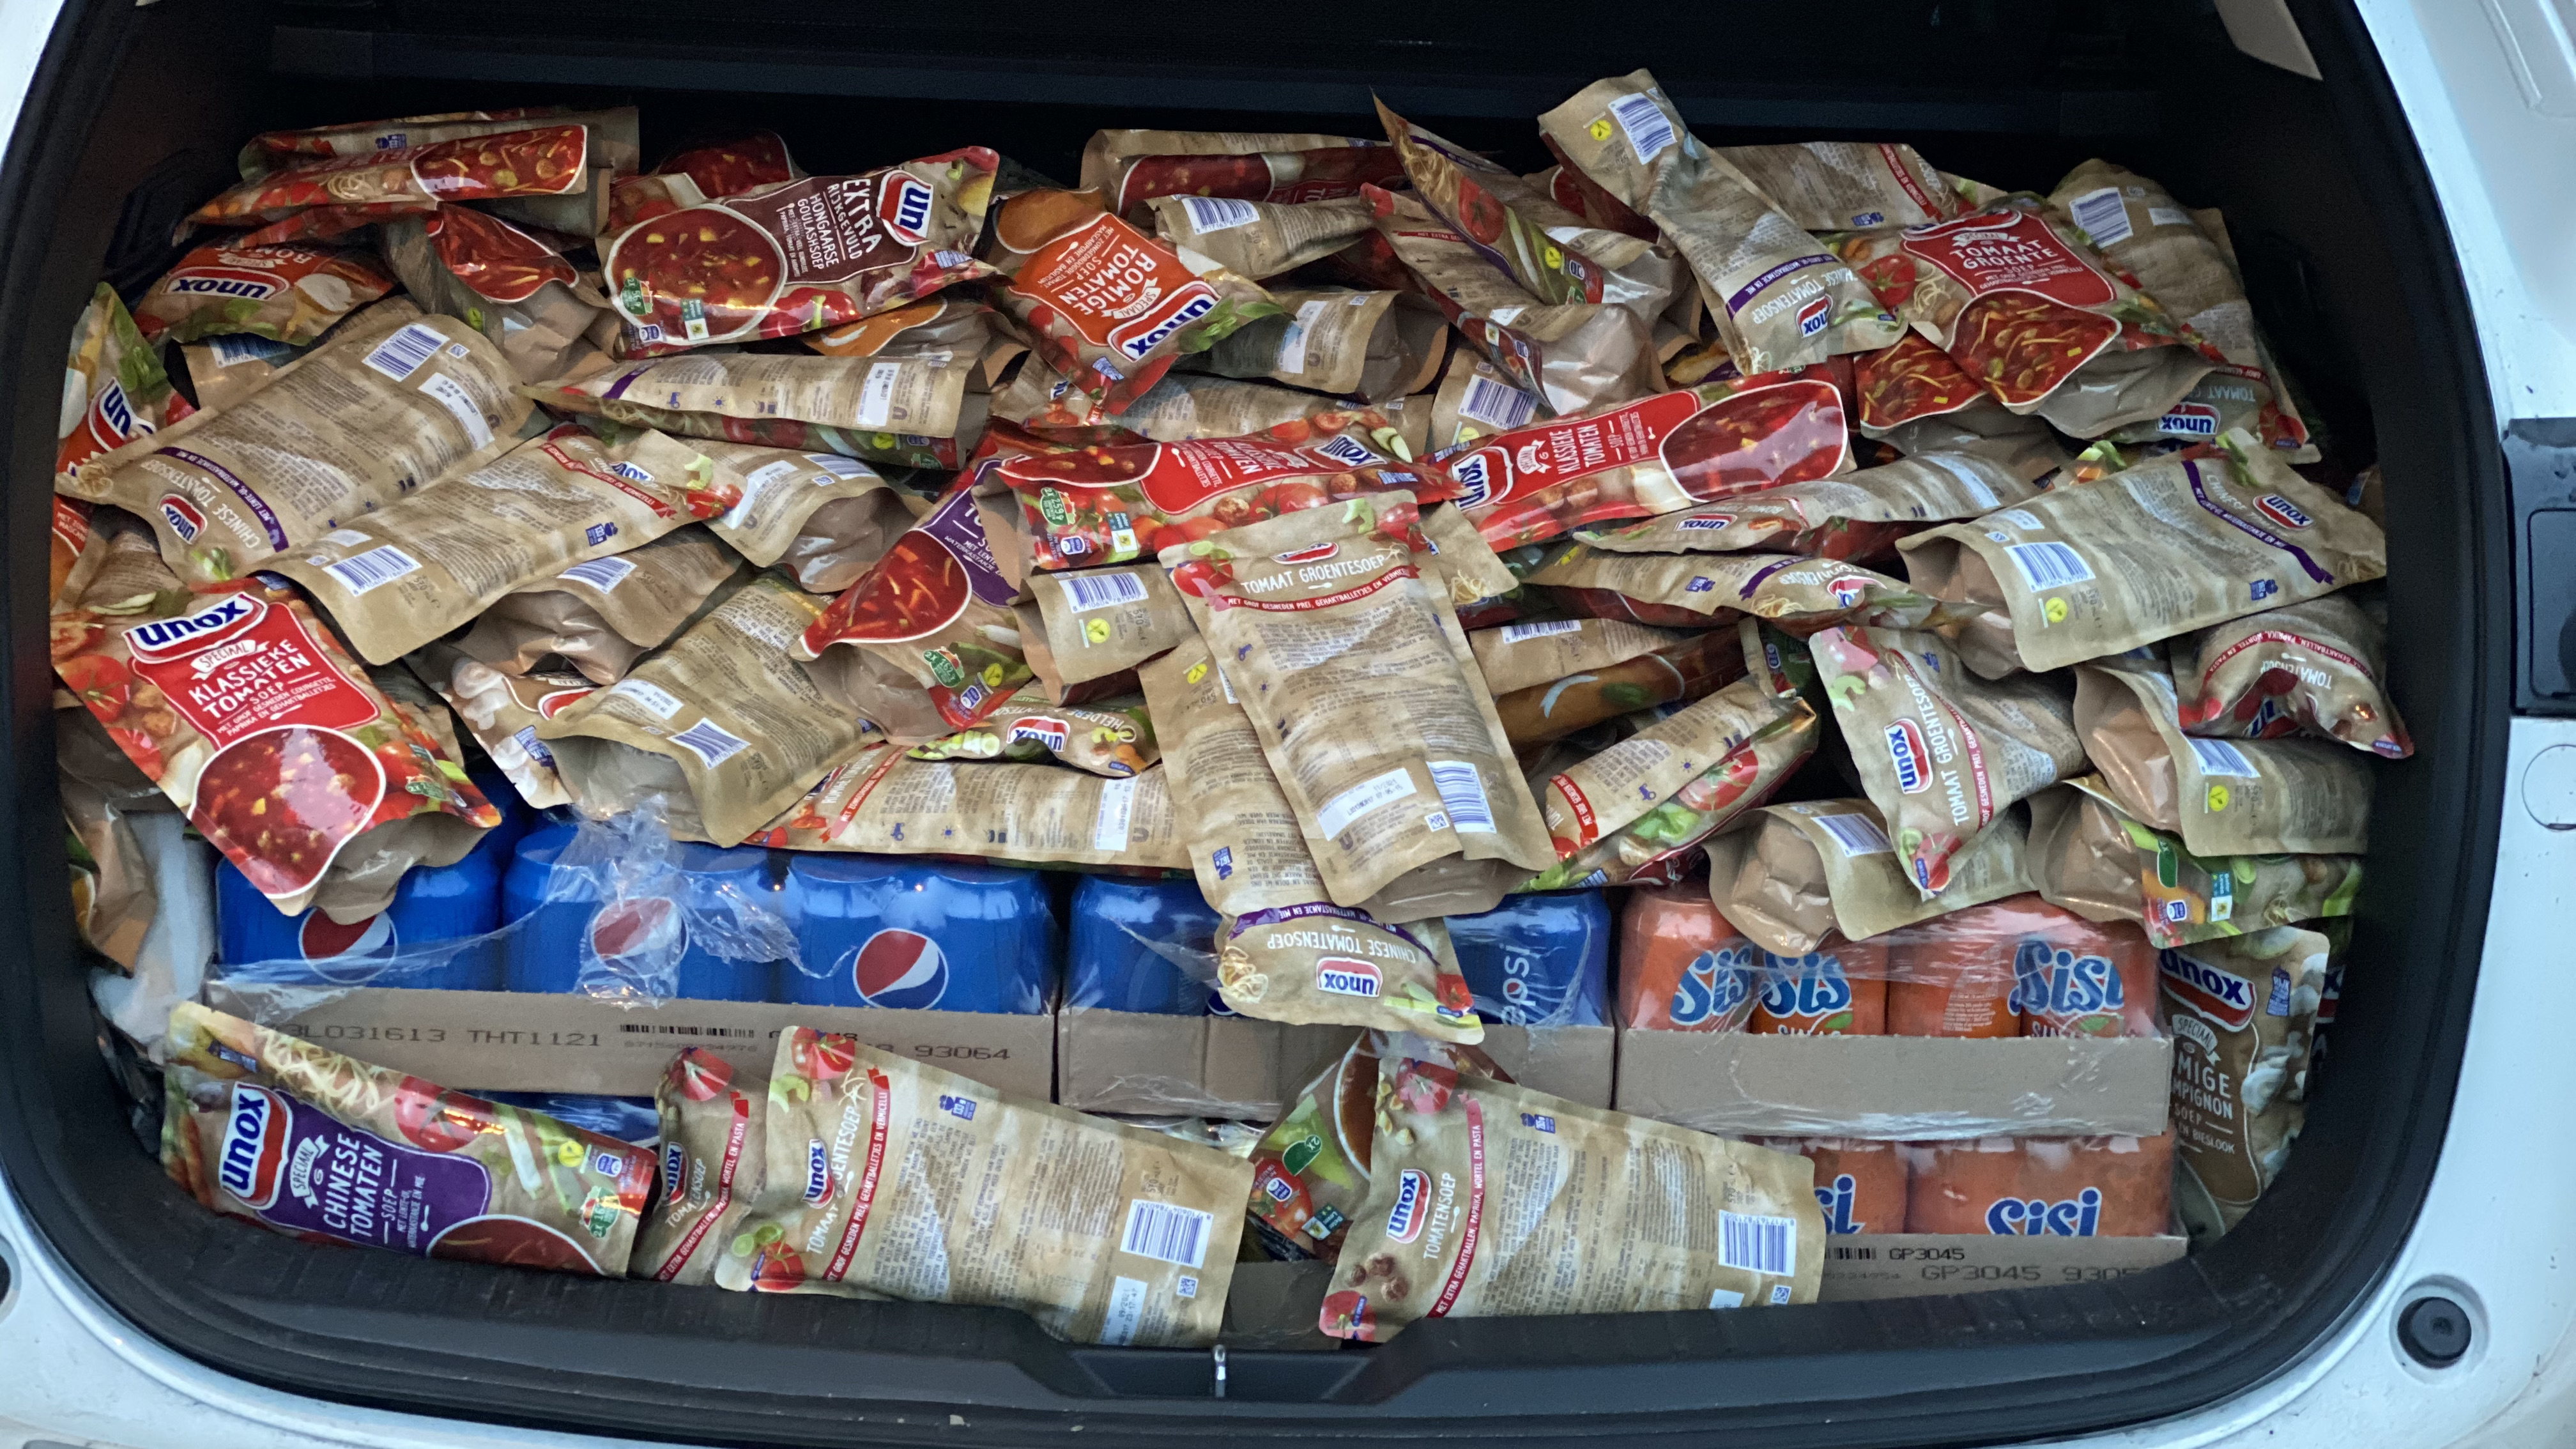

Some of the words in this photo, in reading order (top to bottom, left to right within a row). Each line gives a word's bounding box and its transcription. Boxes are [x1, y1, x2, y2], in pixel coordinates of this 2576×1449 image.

[810, 193, 839, 267] HONGAARSE
[827, 183, 862, 259] RIJKGEVULD
[843, 179, 882, 253] EXTRA
[798, 199, 825, 270] GOULASHSOEP
[1950, 240, 2041, 259] TOMAAT
[1059, 243, 1139, 304] TOMATEN
[1064, 256, 1075, 266] EN
[1077, 256, 1102, 280] SOEP
[1963, 248, 2058, 269] GROENTE
[174, 279, 267, 298] unox
[1073, 252, 1156, 316] ROMIGE
[1121, 292, 1157, 318] SPECIAAL
[1752, 279, 1825, 325] TOMATENSOEP
[1126, 299, 1213, 356] unox
[2207, 384, 2256, 402] TOMAAT
[2161, 417, 2212, 433] unox
[1549, 429, 1581, 474] KLASSIEKE
[1577, 424, 1606, 468] TOMATEN
[212, 503, 261, 549] CHINESE
[2266, 496, 2310, 525] unox
[944, 535, 993, 572] WATERKASTANJE
[963, 540, 976, 551] MET
[1241, 571, 1293, 594] TOMAAT
[1298, 555, 1385, 584] GROENTESOEP
[1262, 601, 1295, 610] GESNEDEN
[1314, 586, 1373, 608] GEHAKTBALLETJES
[135, 600, 248, 646] unox
[188, 639, 300, 705] KLASSIEKE
[200, 643, 249, 668] SPECIAAL
[2209, 655, 2227, 672] PASTA
[203, 653, 312, 718] TOMATEN
[249, 682, 285, 704] SOEP
[216, 721, 232, 734] MET
[233, 709, 252, 724] GROF
[252, 693, 291, 712] GESNEDEN
[227, 717, 259, 736] PAPRIKA
[257, 711, 270, 720] EN
[270, 683, 337, 713] GEHAKTBALLETJES
[1067, 709, 1126, 730] HELDERE
[1903, 674, 1954, 765] GROENTESOEP
[1889, 728, 1917, 788] unox
[1942, 770, 1970, 826] TOMAAT
[1979, 772, 1989, 807] GESNEDEN
[1279, 910, 1291, 919] MIE
[1268, 930, 1363, 954] TOMATENSOEP
[1367, 939, 1416, 964] CHINESE
[1324, 973, 1374, 995] unox
[1499, 943, 1536, 1026] epsi
[466, 1028, 600, 1048] THT1121
[2178, 1017, 2216, 1052] SPECIAAL
[914, 1044, 1011, 1061] 93064
[2177, 1052, 2232, 1099] MIGE
[876, 1092, 887, 1130] VERMICELLI
[954, 1103, 965, 1116] 133
[2172, 1080, 2233, 1120] MPIGNON
[2175, 1103, 2202, 1124] SOEP
[222, 1093, 264, 1191] unox
[732, 1123, 744, 1145] PASTA
[874, 1131, 884, 1142] EN
[1473, 1124, 1482, 1147] PASTA
[2193, 1125, 2235, 1154] BIESLOOK
[293, 1146, 314, 1190] SPECIAAL
[728, 1147, 738, 1156] EN
[1474, 1150, 1483, 1160] EN
[323, 1133, 360, 1229] CHINESE
[722, 1160, 735, 1184] WORTEL
[806, 1146, 824, 1199] unox
[859, 1141, 883, 1202] GEHAKTBALLETJES
[1474, 1162, 1483, 1188] WORTEL
[351, 1144, 384, 1238] TOMATEN
[381, 1188, 398, 1222] SOEP
[1388, 1176, 1418, 1232] unox
[853, 1202, 868, 1222] PREI,
[1423, 1172, 1456, 1259] TOMATENSOEP
[1470, 1192, 1483, 1225] PAPRIKA,
[806, 1203, 839, 1254] TOMAAT
[841, 1222, 861, 1256] GESNEDEN
[666, 1257, 682, 1274] EXTRA
[835, 1254, 847, 1273] GROF
[1455, 1227, 1478, 1279] GEHAKTBALLEN,
[1889, 1246, 1965, 1261] GP3045
[1446, 1275, 1459, 1300] EXTRA
[1921, 1264, 2042, 1282] GP3045
[1436, 1298, 1449, 1314] MET
